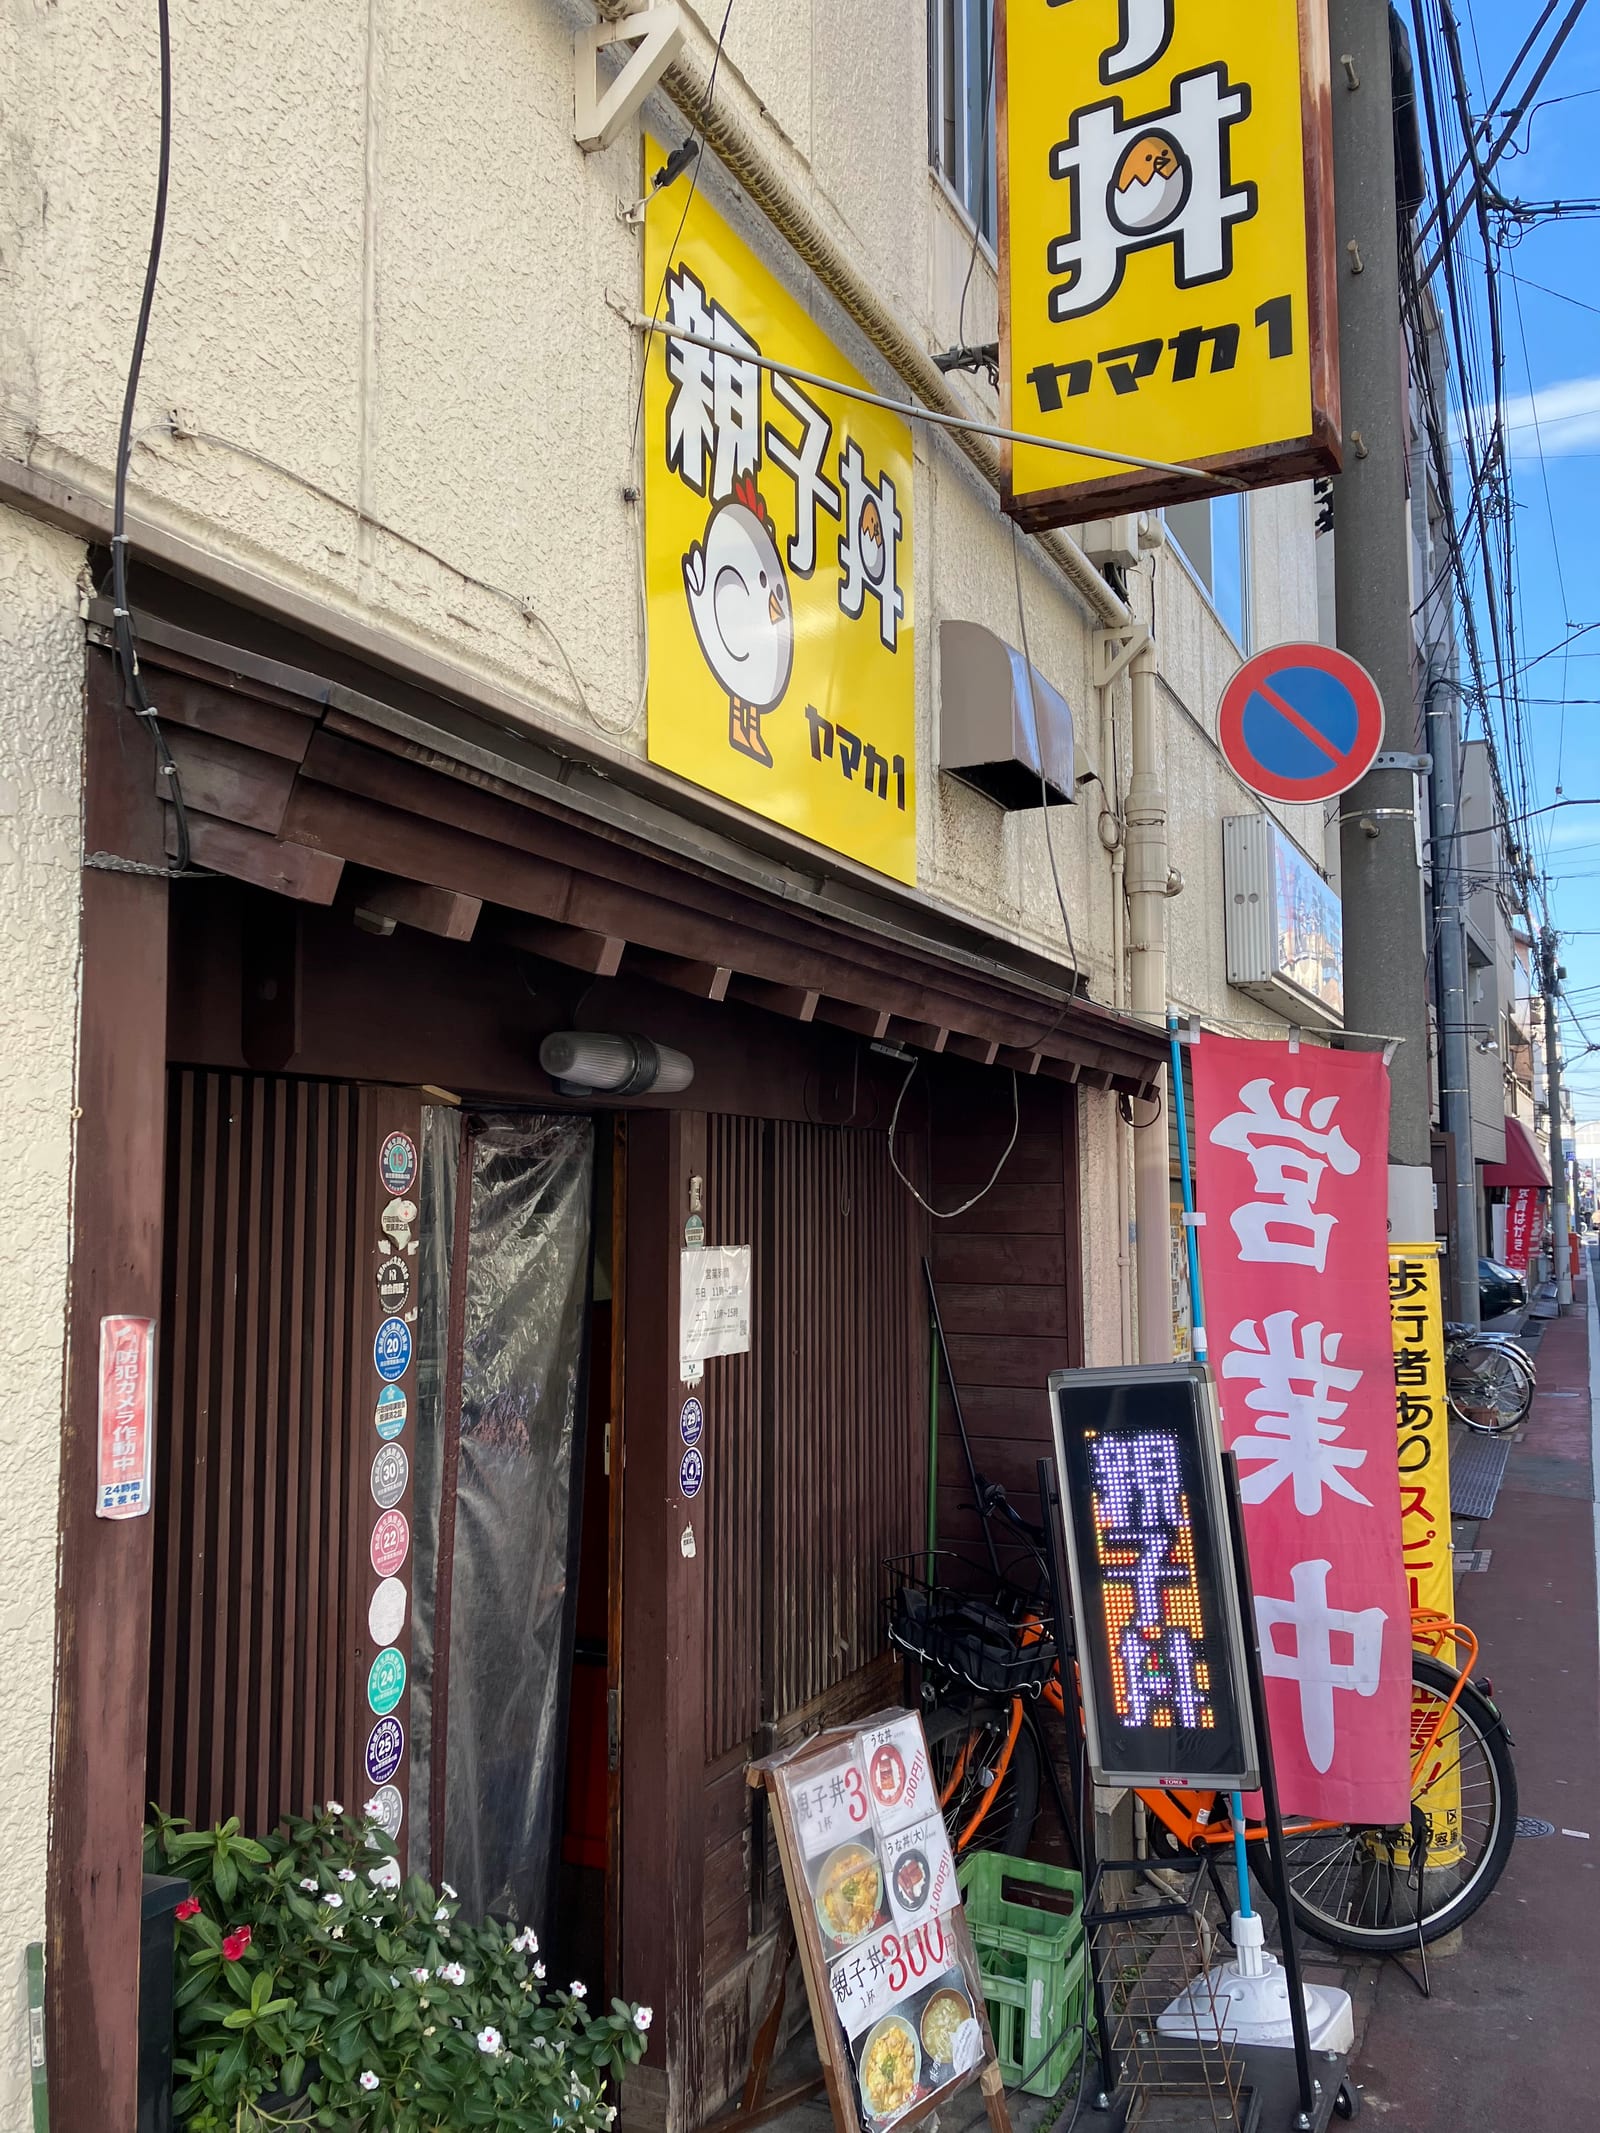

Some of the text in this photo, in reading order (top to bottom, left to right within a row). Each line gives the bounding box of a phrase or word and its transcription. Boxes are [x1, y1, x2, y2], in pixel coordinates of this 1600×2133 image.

[1026, 294, 1294, 414] ヤマカ1
[666, 261, 905, 654] 親子丼
[804, 702, 907, 812] ヤマカ1
[393, 1152, 404, 1166] 19
[386, 1338, 399, 1354] 20
[112, 1350, 139, 1472] 防犯カメラ作動中
[1209, 1077, 1389, 1775] 営業中
[383, 1463, 396, 1481] 30
[104, 1481, 141, 1496] 24時間
[383, 1530, 397, 1549] 22
[380, 1669, 393, 1687] 24
[377, 1735, 391, 1757] 25
[870, 1728, 892, 1748] うな丼
[831, 1944, 887, 2005] 親子丼
